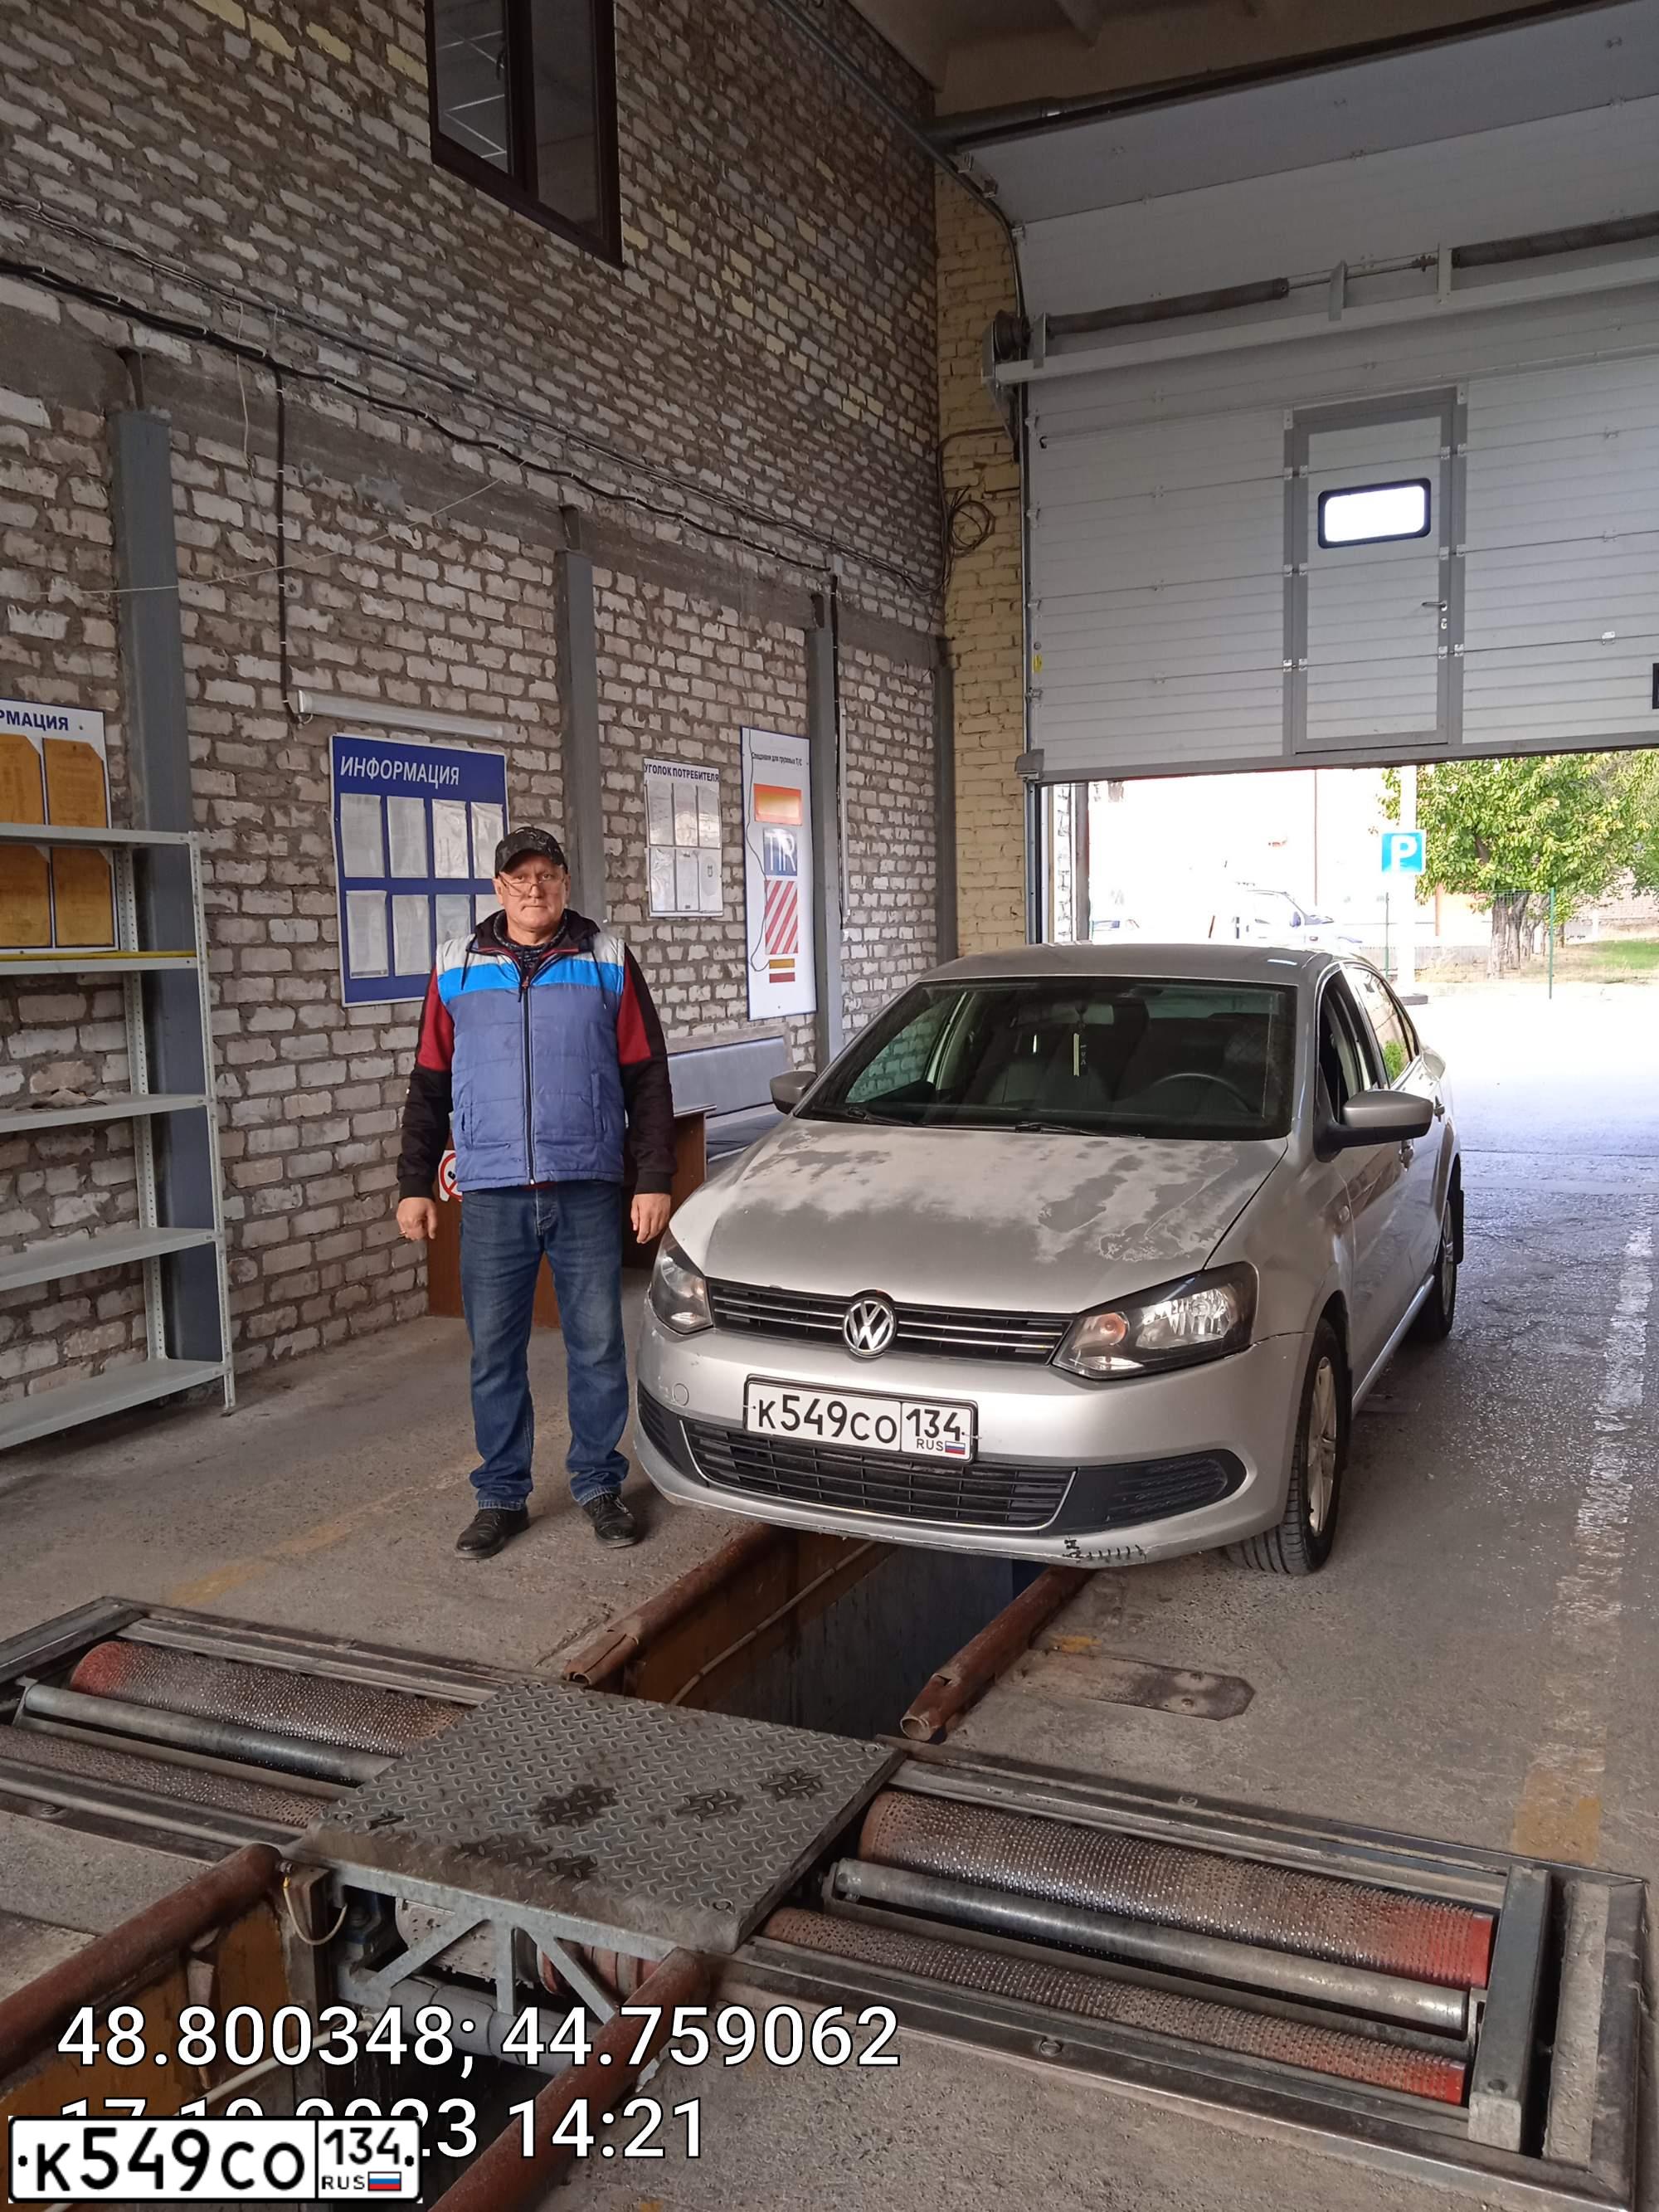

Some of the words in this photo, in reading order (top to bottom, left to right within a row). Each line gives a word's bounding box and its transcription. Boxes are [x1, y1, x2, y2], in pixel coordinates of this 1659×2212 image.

[340, 756, 460, 789] ИНФОРМАЦИЯ
[644, 763, 672, 777] УГОЛОК
[673, 767, 719, 782] ПОТРЕБИТЕЛЯ
[1391, 836, 1417, 871] P
[906, 1408, 961, 1441] 134
[916, 1438, 944, 1451] RUS
